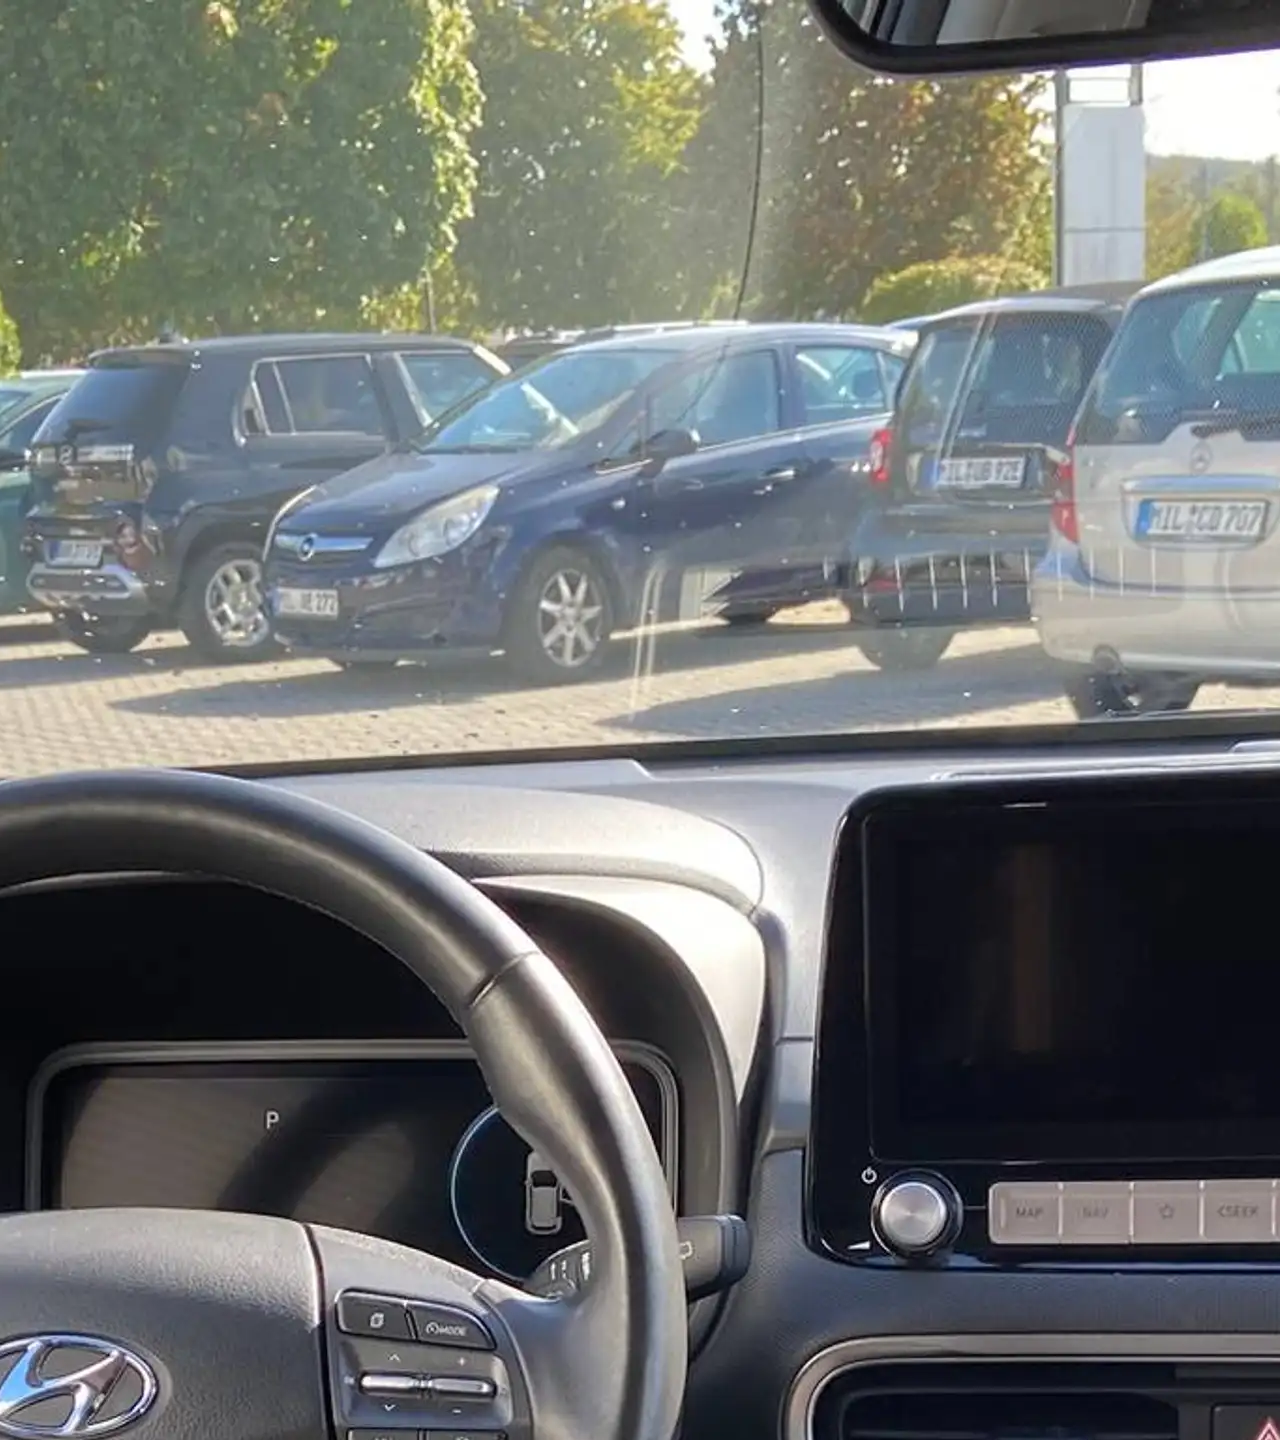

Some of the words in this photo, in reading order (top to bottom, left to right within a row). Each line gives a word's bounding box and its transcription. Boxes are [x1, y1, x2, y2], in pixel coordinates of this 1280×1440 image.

[266, 1110, 280, 1130] P
[1016, 1206, 1044, 1219] MAP
[1081, 1206, 1109, 1219] NAV
[439, 1325, 467, 1337] MODE
